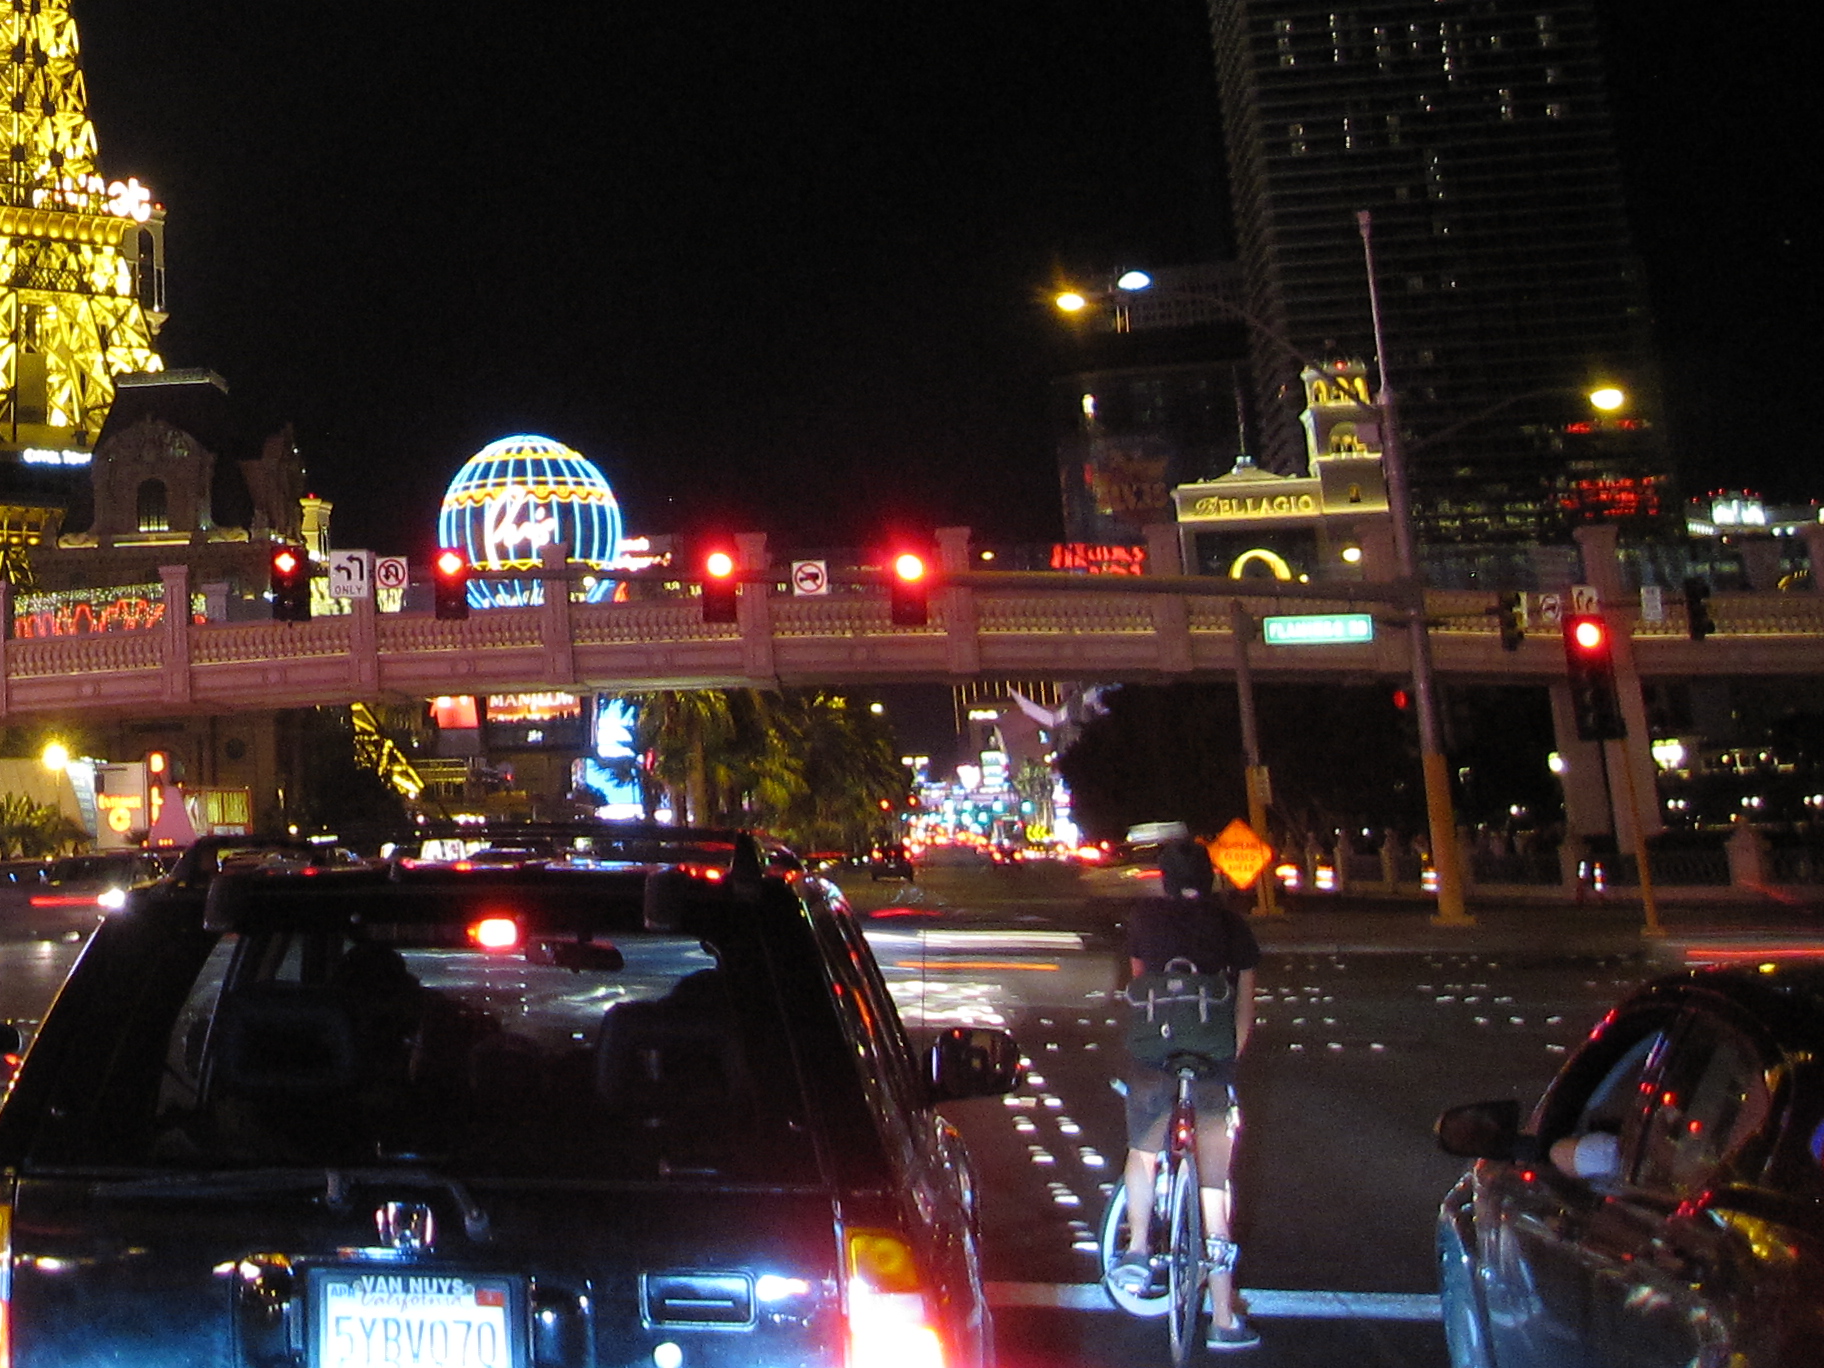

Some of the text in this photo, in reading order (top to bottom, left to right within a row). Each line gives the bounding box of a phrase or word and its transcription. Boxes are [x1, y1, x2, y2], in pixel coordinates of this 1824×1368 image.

[1194, 494, 1314, 516] BELLAGIO
[334, 585, 364, 595] ONLY
[360, 1275, 464, 1296] VAN NUYS
